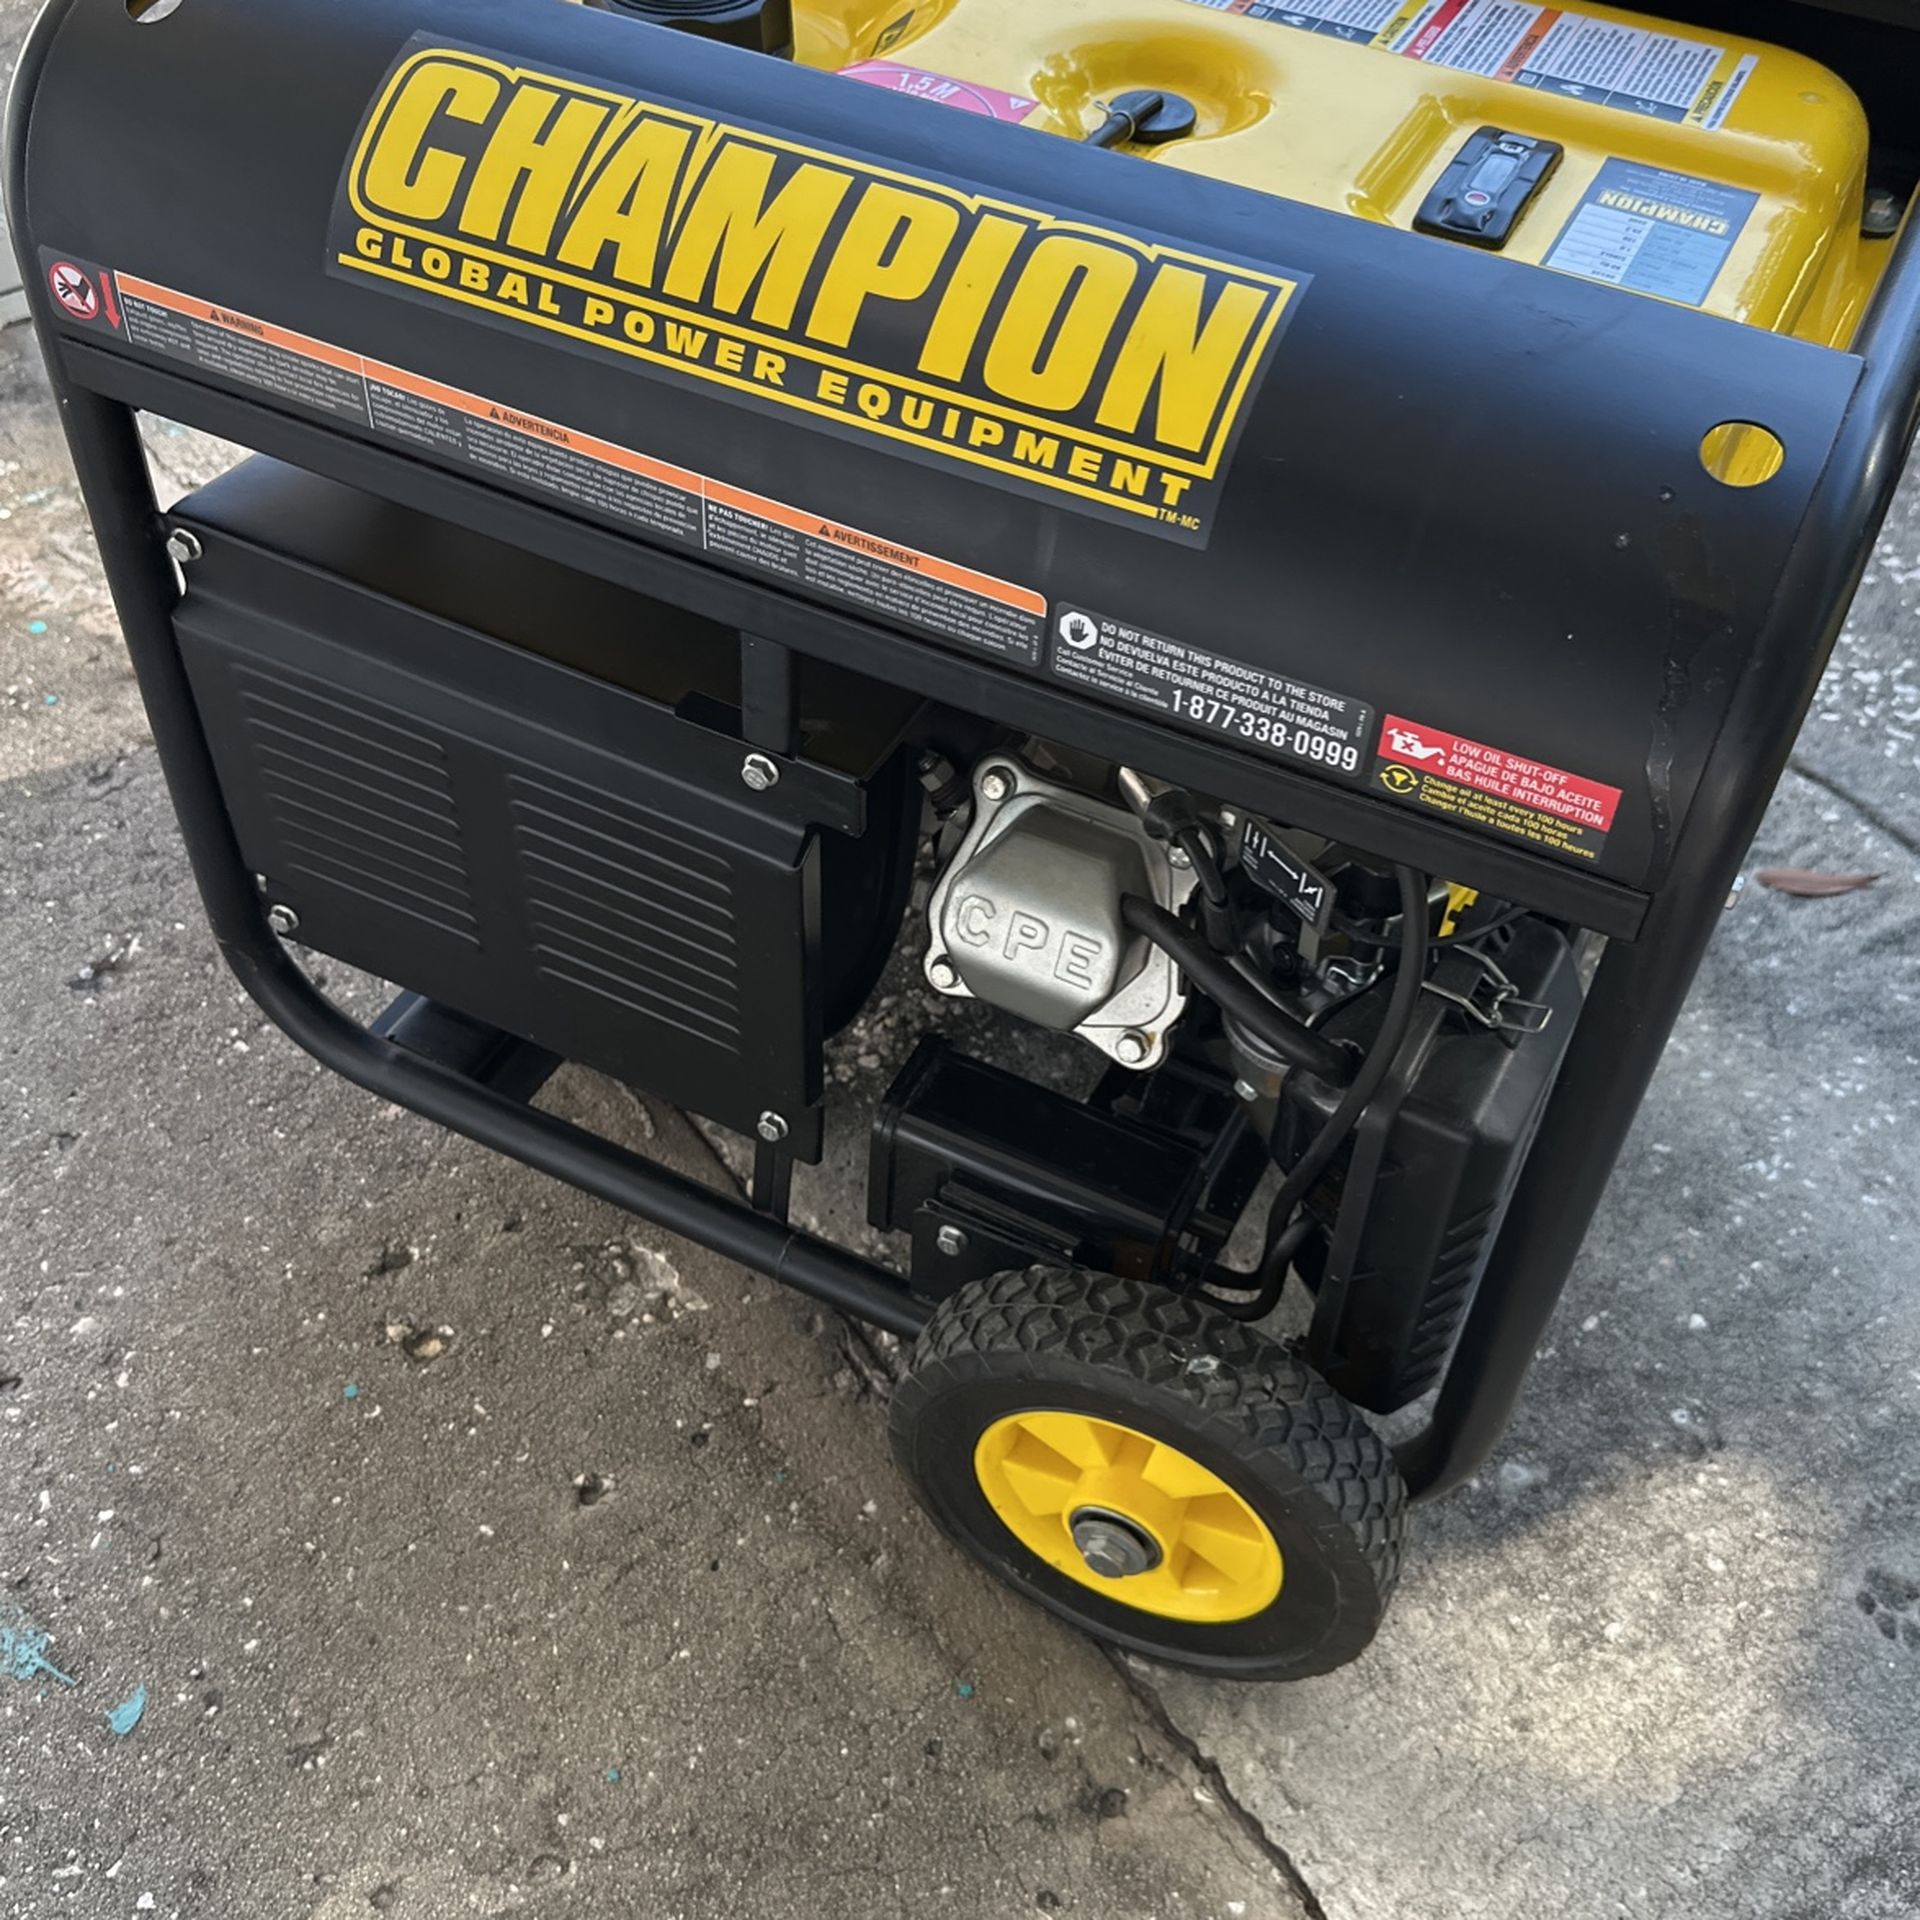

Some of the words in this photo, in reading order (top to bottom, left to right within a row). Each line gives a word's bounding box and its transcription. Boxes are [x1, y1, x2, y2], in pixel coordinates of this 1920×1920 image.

[1598, 189, 1730, 237] CHAMPION
[366, 63, 1268, 452] CHAMPION
[221, 312, 265, 337] WARNING
[356, 228, 560, 314] GLOBAL
[583, 297, 786, 386] POWER
[797, 370, 1191, 506] EQUIPMENT
[502, 411, 570, 444] ADVERTENCIA
[833, 529, 920, 568] AVERTISSEMENT
[1056, 646, 1070, 656] Call
[1072, 651, 1104, 668] Customer
[1106, 662, 1133, 677] Service
[1099, 635, 1114, 648] NO
[1116, 641, 1170, 667] DEVUELVA
[1172, 659, 1199, 677] ESTE
[1200, 669, 1260, 697] PRODUCTO
[1261, 689, 1270, 701] A
[1271, 692, 1288, 706] LA
[1288, 698, 1330, 721] TIENDA
[1101, 621, 1116, 635] DO
[1118, 627, 1139, 643] NOT
[1141, 635, 1185, 658] RETURN
[1187, 650, 1212, 667] THIS
[1213, 659, 1265, 685] PRODUCT
[1266, 676, 1282, 690] TO
[1283, 682, 1306, 698] THE
[1307, 690, 1346, 711] STORE
[1135, 660, 1150, 673] DE
[1151, 665, 1214, 695] RETOURNER
[1215, 686, 1230, 700] CE
[1230, 692, 1278, 716] PRODUIT
[1278, 708, 1294, 722] AU
[1295, 714, 1348, 740] MAGASIN
[1169, 687, 1358, 772] 1-877-338-0999
[1449, 752, 1498, 777] APAGUE
[1500, 770, 1518, 784] DE
[1520, 776, 1555, 796] BAJO
[1556, 788, 1602, 811] ACEITE
[1452, 740, 1480, 758] LOW
[1482, 750, 1503, 765] OIL
[1505, 757, 1567, 787] SHUT-OFF
[1423, 775, 1457, 793] Change
[1459, 787, 1471, 798] oil
[1472, 791, 1482, 801] at
[1483, 795, 1507, 809] least
[1508, 803, 1534, 819] every
[1536, 813, 1554, 825] 100
[1554, 819, 1583, 835] hours
[1446, 765, 1471, 781] BAS
[1474, 774, 1510, 794] HUILE
[1512, 786, 1604, 825] INTERRUPTION
[1467, 799, 1496, 815] aceite
[1497, 809, 1520, 823] cada
[1523, 818, 1540, 829] 100
[1540, 824, 1568, 839] horas
[956, 894, 1102, 990] CPE
